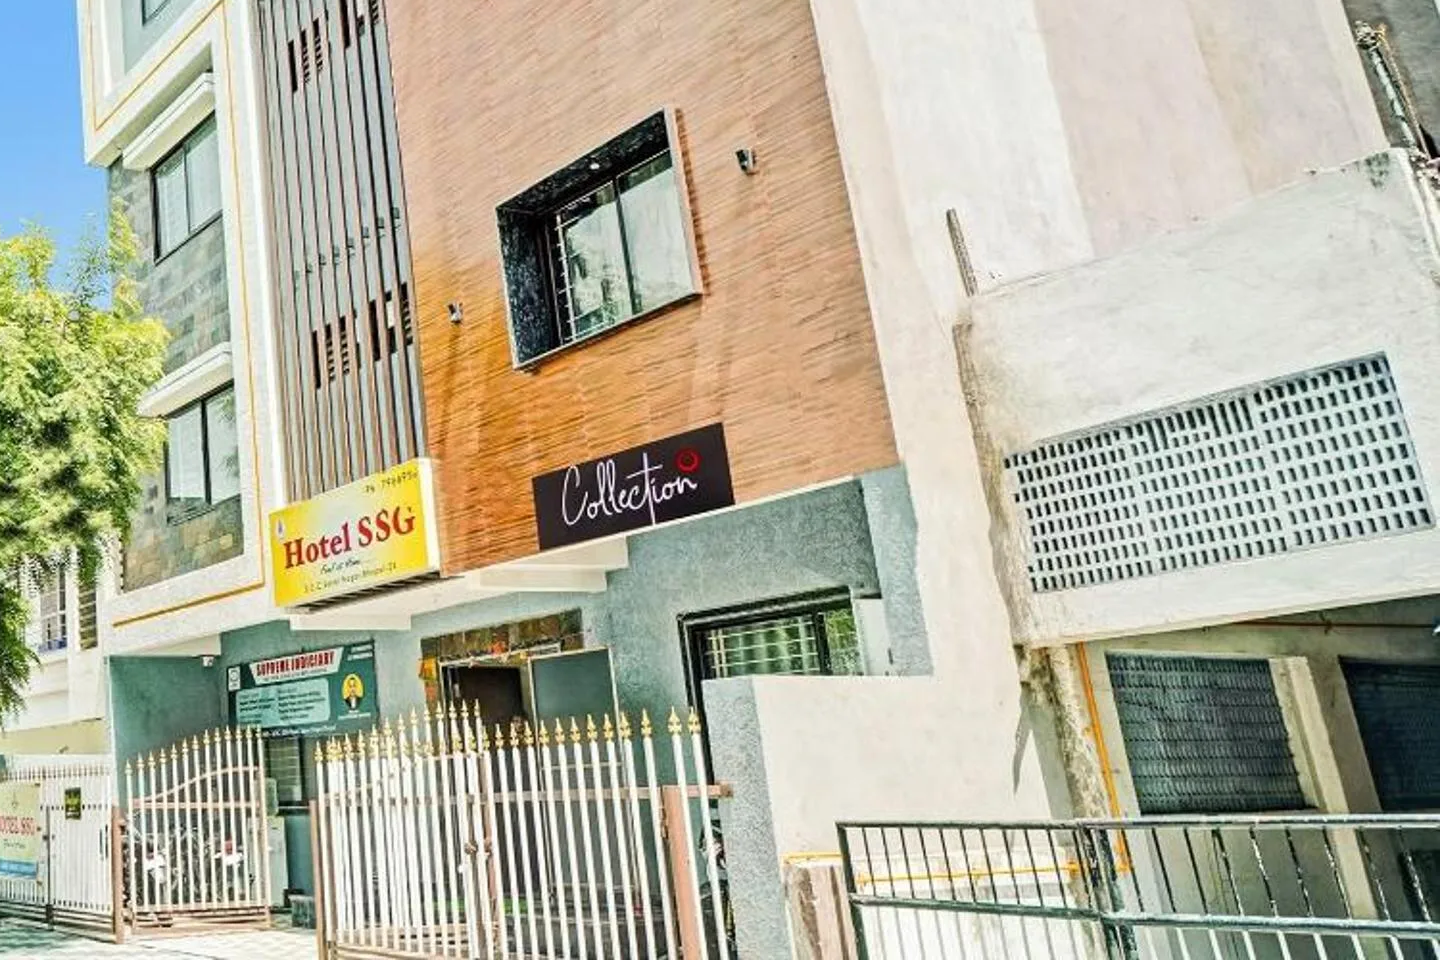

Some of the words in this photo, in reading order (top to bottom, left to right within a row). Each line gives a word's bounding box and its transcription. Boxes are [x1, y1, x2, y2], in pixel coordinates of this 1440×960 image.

[562, 452, 698, 526] Collection
[283, 522, 352, 569] Hotel
[357, 506, 416, 547] SSG
